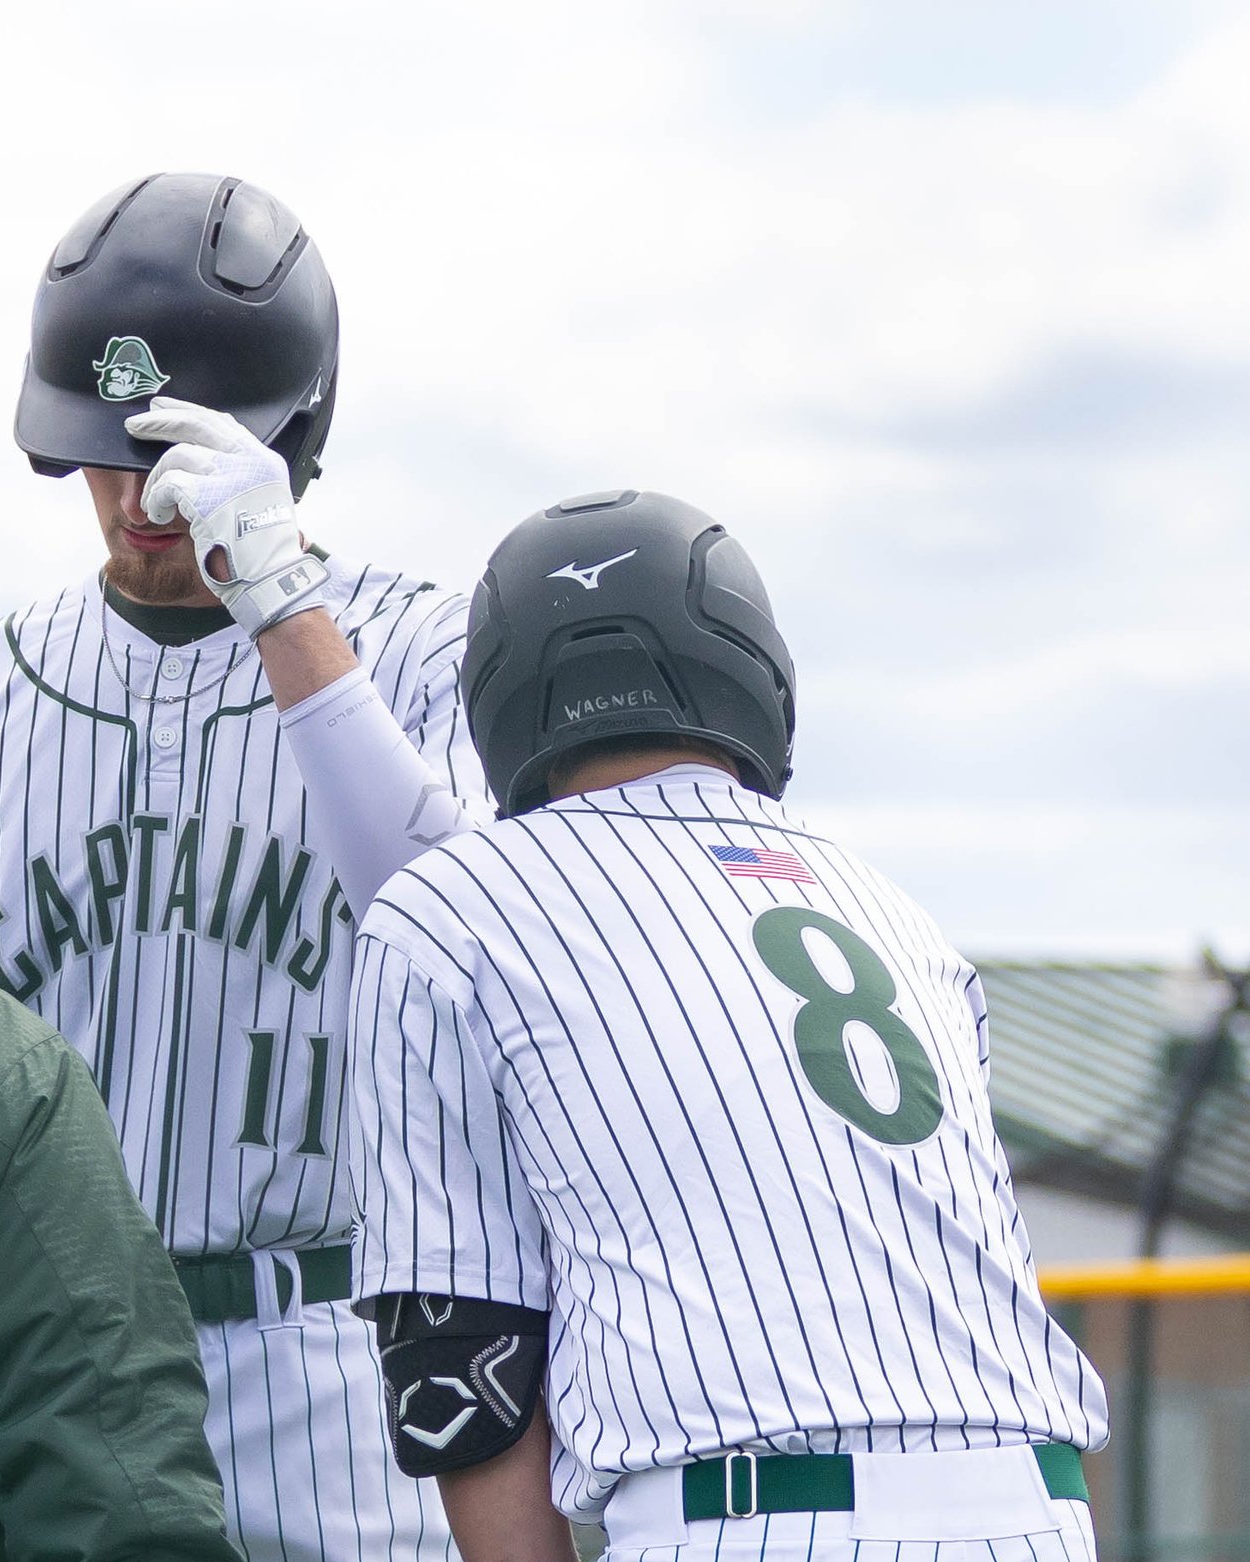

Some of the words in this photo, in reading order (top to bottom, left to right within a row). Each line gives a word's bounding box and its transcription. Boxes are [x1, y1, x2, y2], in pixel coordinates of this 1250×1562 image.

[564, 689, 658, 721] WAGNER
[751, 904, 946, 1148] 8
[230, 1027, 333, 1160] 11
